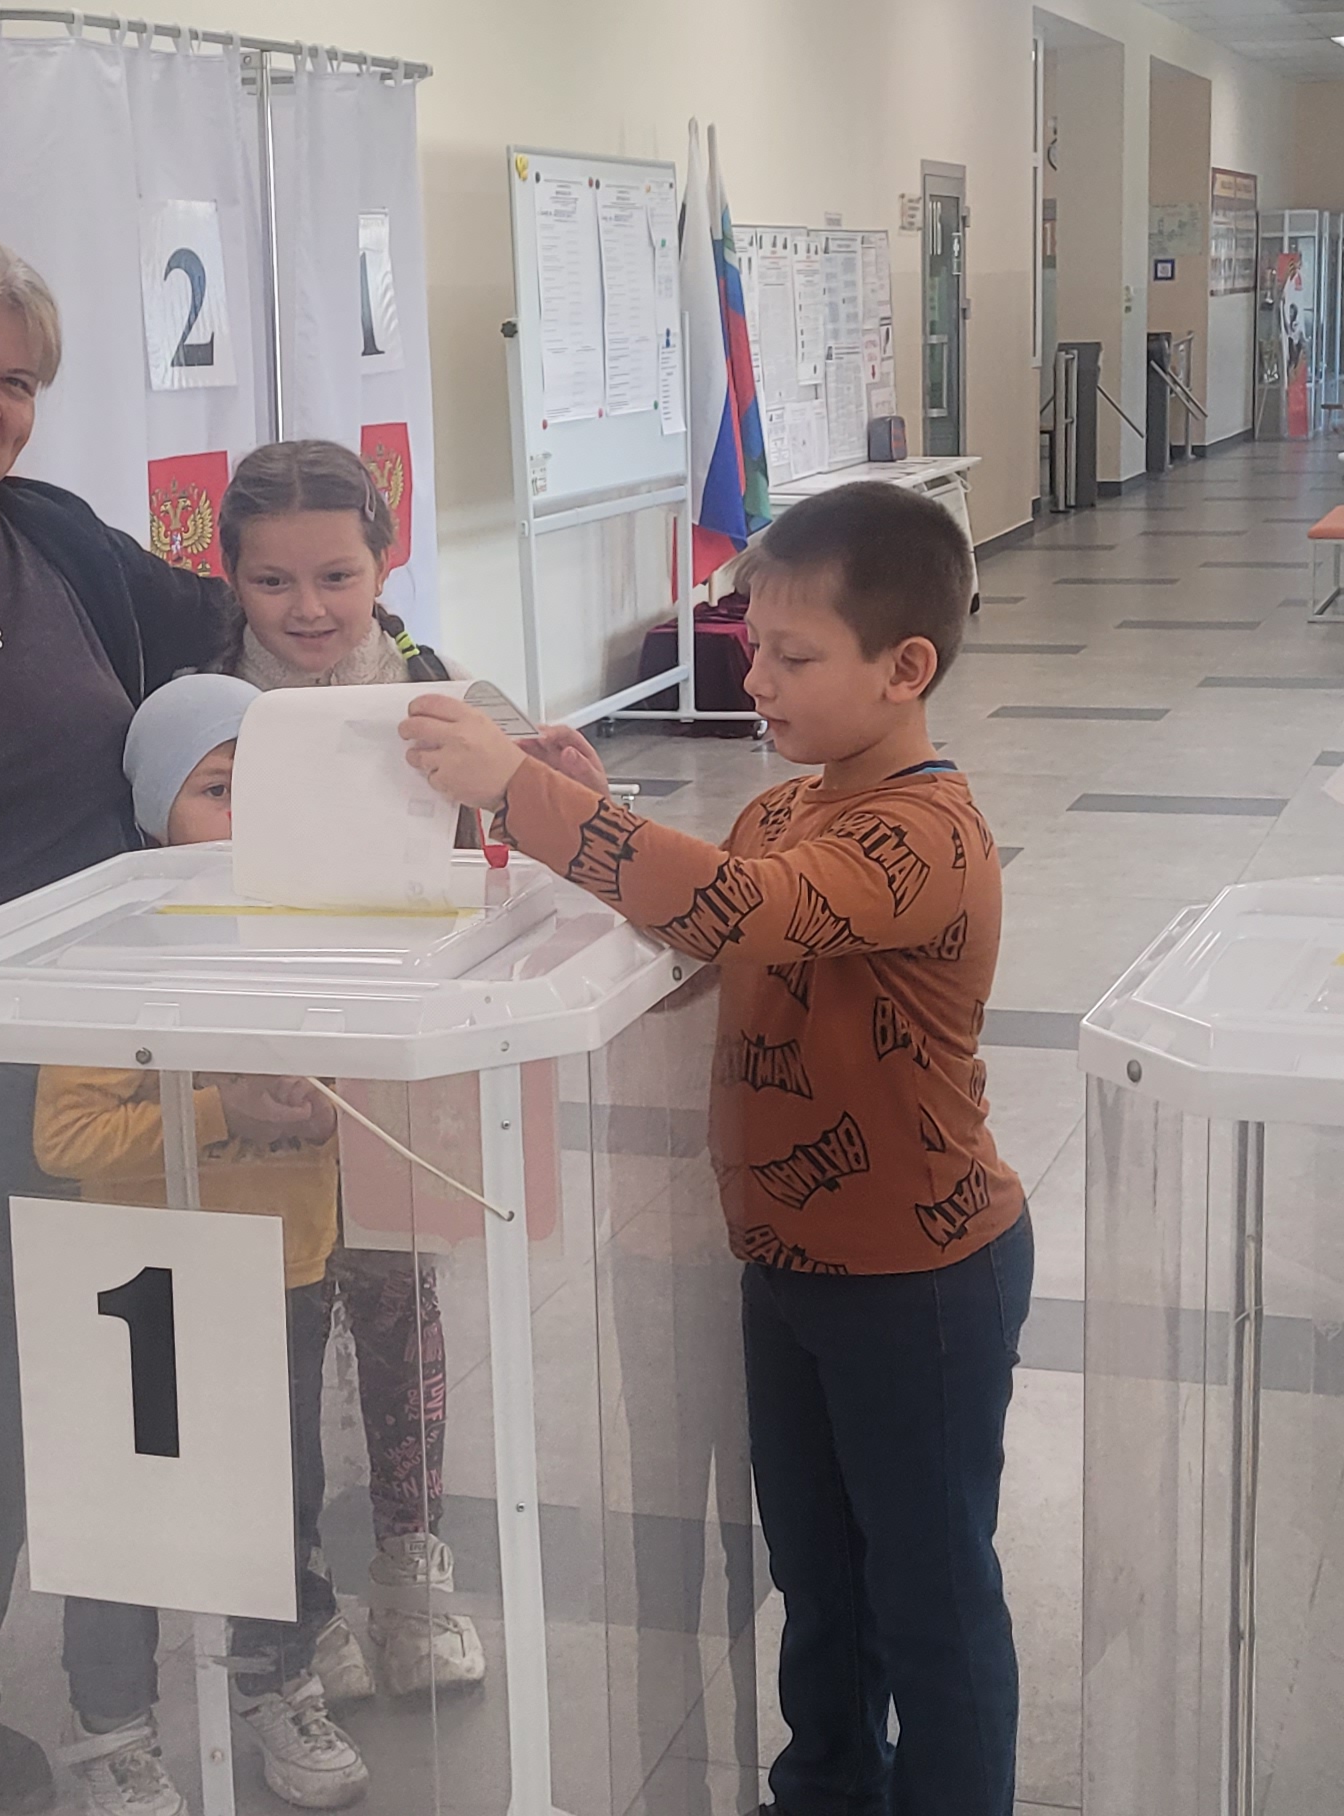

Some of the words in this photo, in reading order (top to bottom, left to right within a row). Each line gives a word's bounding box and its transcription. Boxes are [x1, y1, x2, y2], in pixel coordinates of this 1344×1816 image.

[163, 247, 214, 367] 2
[749, 1111, 869, 1210] BATMAN
[97, 1266, 180, 1458] 1
